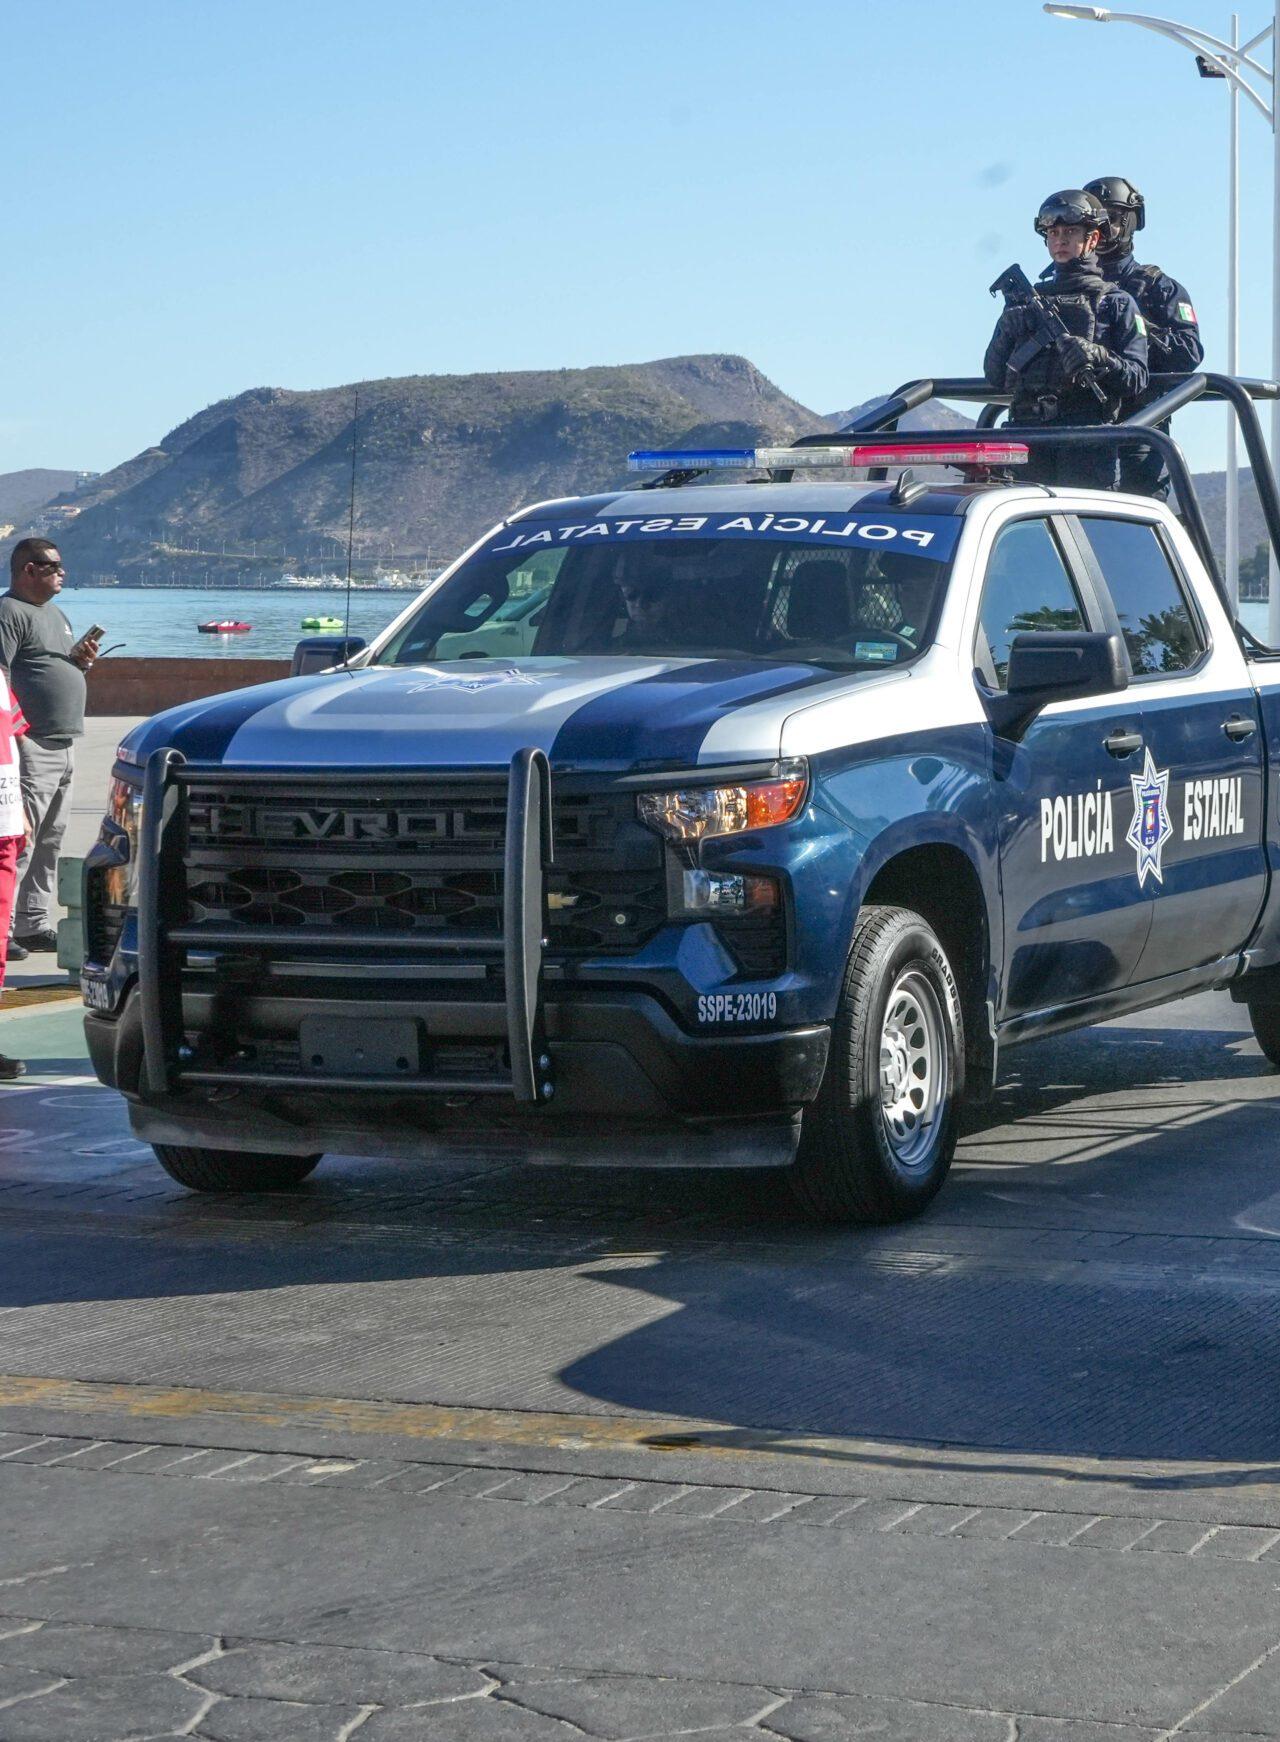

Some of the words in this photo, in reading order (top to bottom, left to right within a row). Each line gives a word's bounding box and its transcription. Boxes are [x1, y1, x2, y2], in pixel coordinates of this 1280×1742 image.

[1041, 779, 1113, 862] POLICÍA
[1184, 777, 1243, 841] ESTATAL
[698, 992, 777, 1022] SSPE-23019
